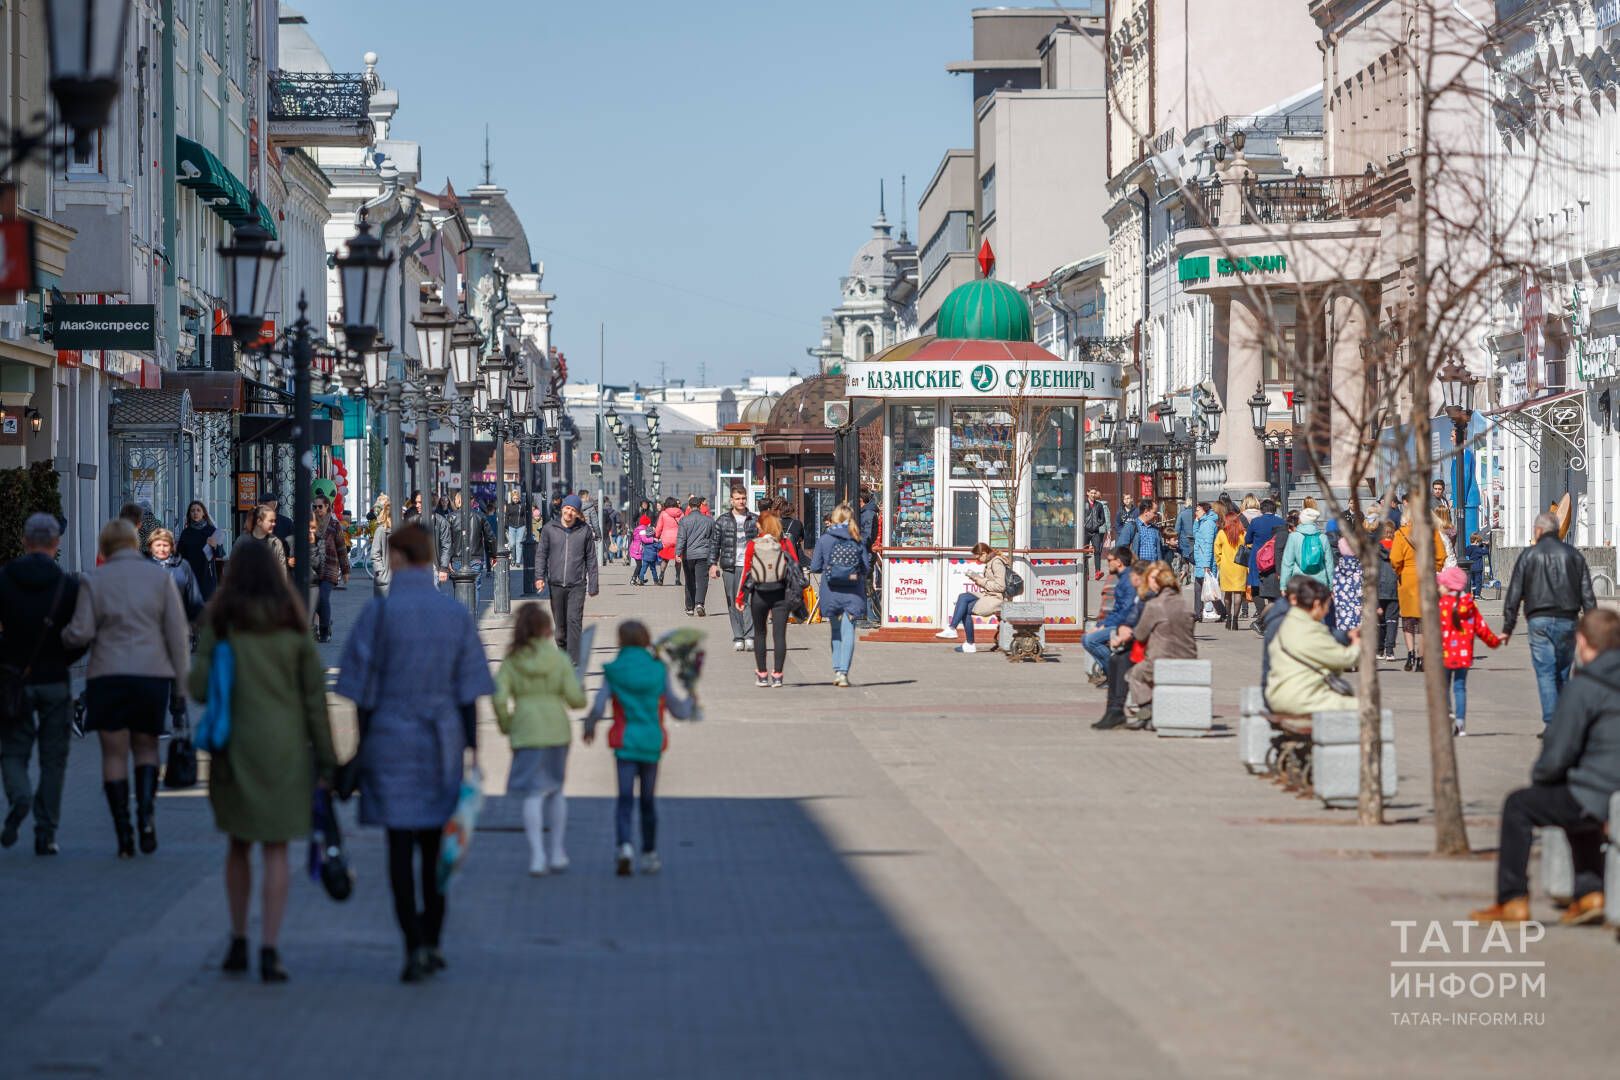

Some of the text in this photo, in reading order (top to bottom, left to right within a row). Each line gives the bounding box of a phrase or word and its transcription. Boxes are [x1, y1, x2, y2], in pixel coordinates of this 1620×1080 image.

[1217, 255, 1287, 274] RESAURANT
[60, 321, 150, 332] МакЭкспресс
[867, 370, 962, 389] КАЗАНСКИЕ
[1005, 369, 1095, 389] СУВЕНИРЫ
